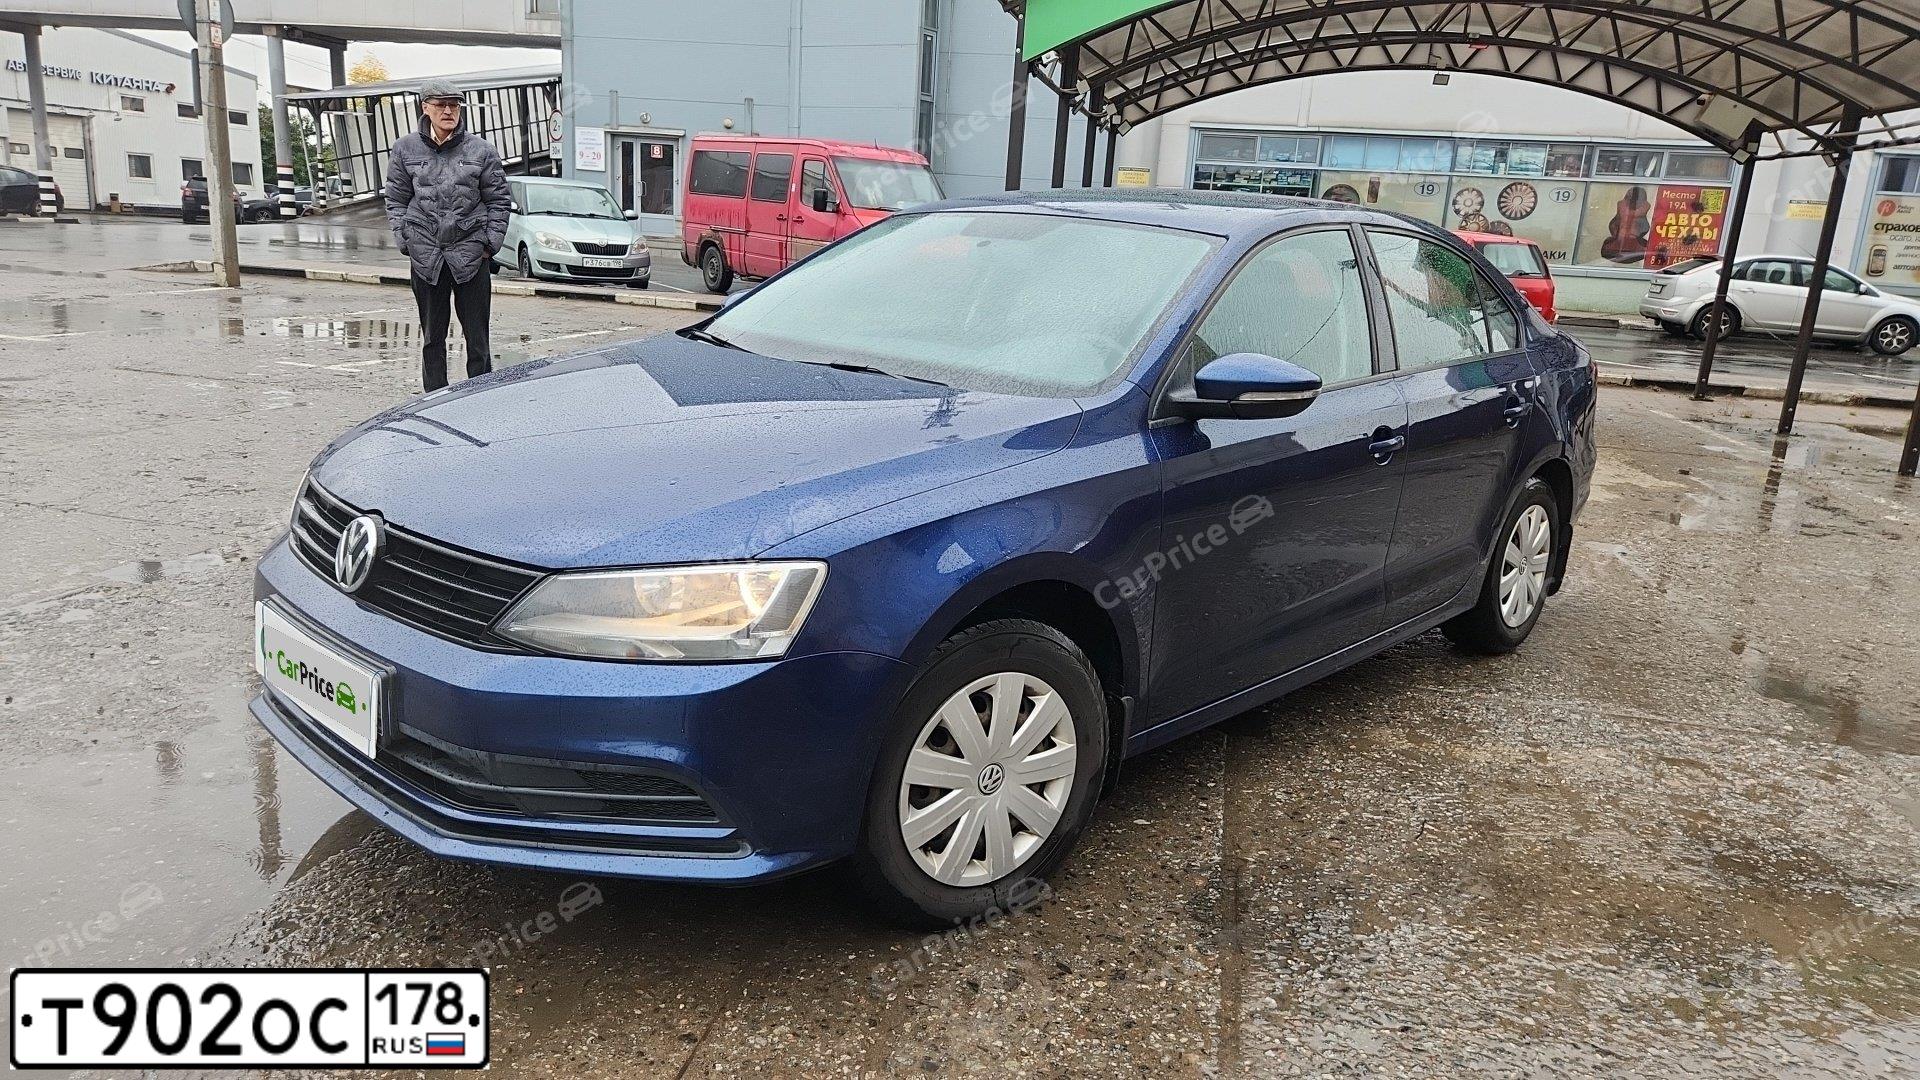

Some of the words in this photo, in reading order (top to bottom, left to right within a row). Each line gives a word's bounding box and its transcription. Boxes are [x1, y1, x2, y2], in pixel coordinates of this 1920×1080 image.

[91, 71, 161, 93] КИТАЯНА
[579, 151, 584, 159] 9
[592, 151, 602, 160] 20
[1420, 184, 1435, 195] 19
[1663, 190, 1697, 200] Место
[1555, 190, 1571, 202] 19
[1664, 212, 1713, 227] АВТО
[1656, 225, 1719, 240] ЧЕХЛЫ
